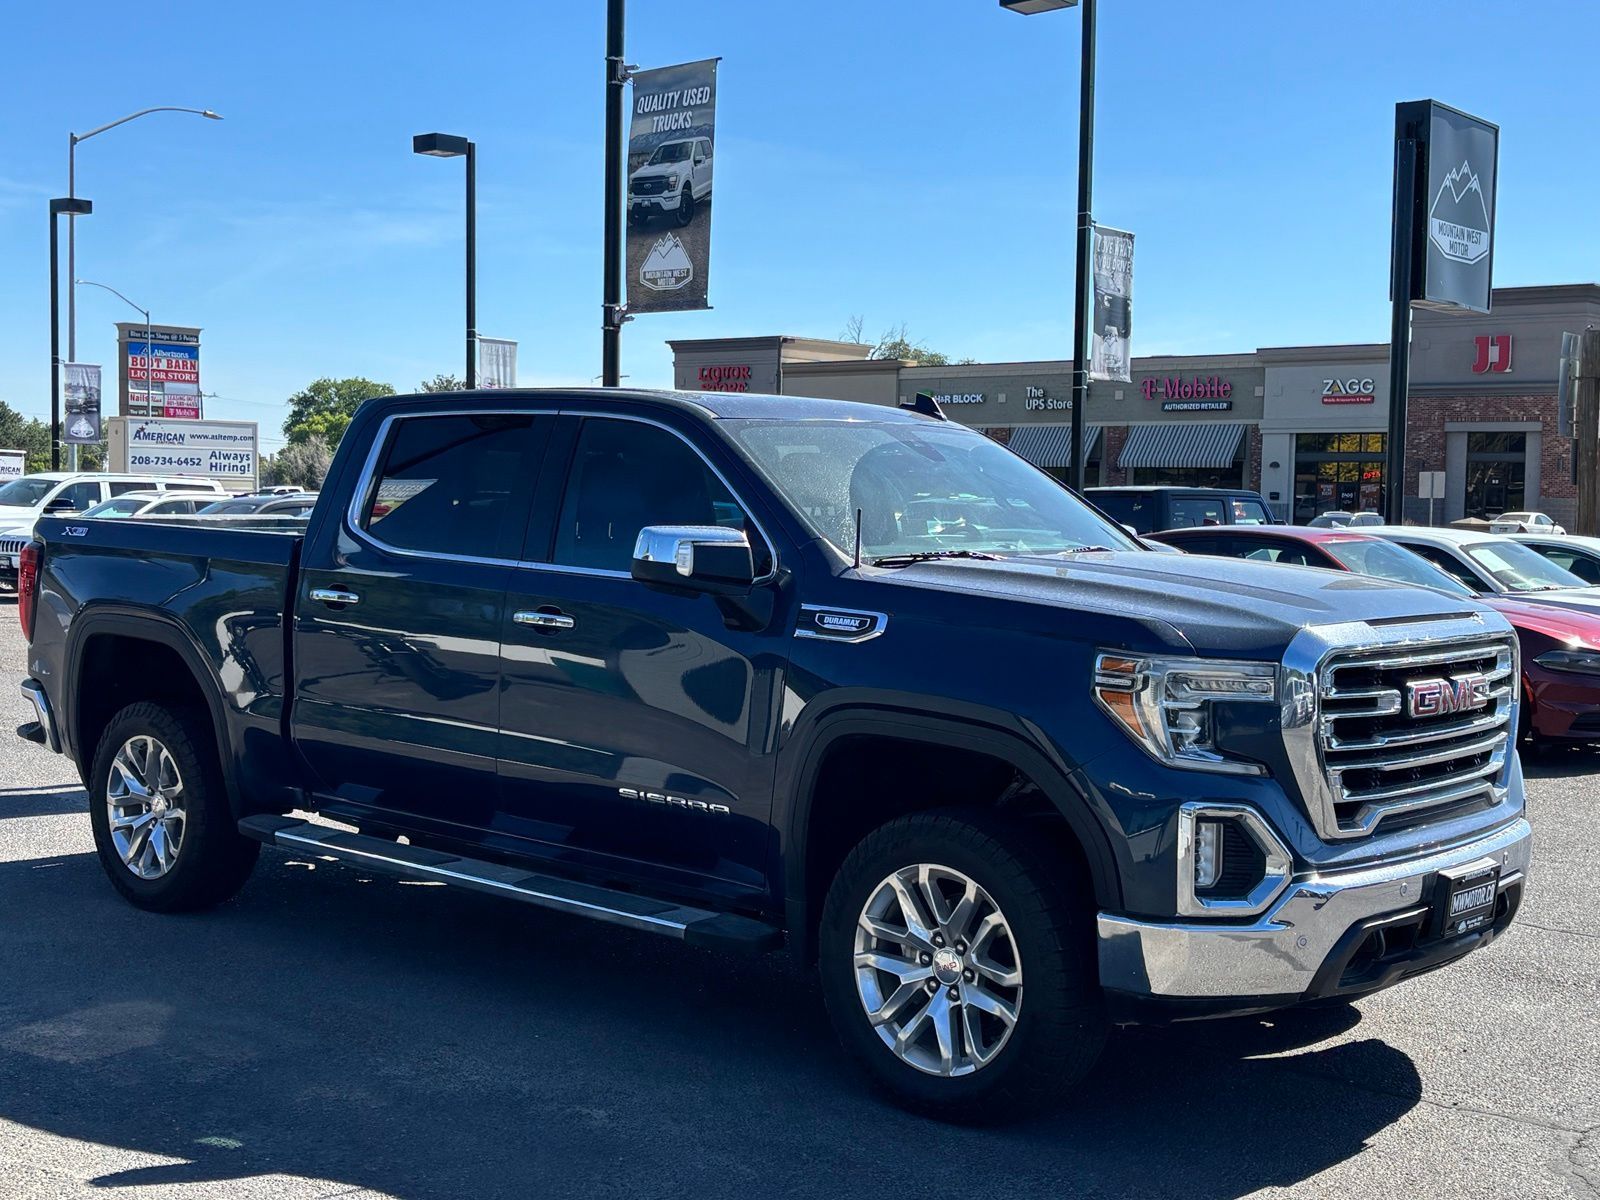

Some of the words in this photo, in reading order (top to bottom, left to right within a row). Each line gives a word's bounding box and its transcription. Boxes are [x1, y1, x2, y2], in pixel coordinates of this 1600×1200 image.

[637, 91, 680, 114] QUALITY
[682, 86, 711, 107] USED
[652, 111, 693, 133] TRUCKS
[1438, 221, 1465, 241] MOUNTAIN
[1466, 229, 1482, 246] WEST
[1449, 239, 1469, 257] MOTOR
[673, 269, 688, 277] WEST
[153, 348, 189, 359] Albertsons
[166, 358, 197, 371] BARN
[131, 370, 166, 379] LIQOR
[167, 371, 197, 381] STORE
[697, 366, 750, 381] LIQUOR
[1026, 386, 1044, 397] The
[1141, 376, 1232, 400] T-Mobile
[1322, 378, 1374, 395] ZAGG
[953, 394, 983, 403] BLOCK
[1025, 399, 1044, 410] UPS
[1047, 399, 1073, 409] Store
[1200, 402, 1228, 410] RETAILER
[133, 430, 186, 442] AMERICAN
[131, 455, 202, 467] 208-734-6452
[209, 451, 251, 463] Always
[209, 462, 251, 475] Hiring!
[823, 616, 860, 627] DURAMAX
[1408, 674, 1488, 717] GMC
[618, 787, 730, 814] SIERRA
